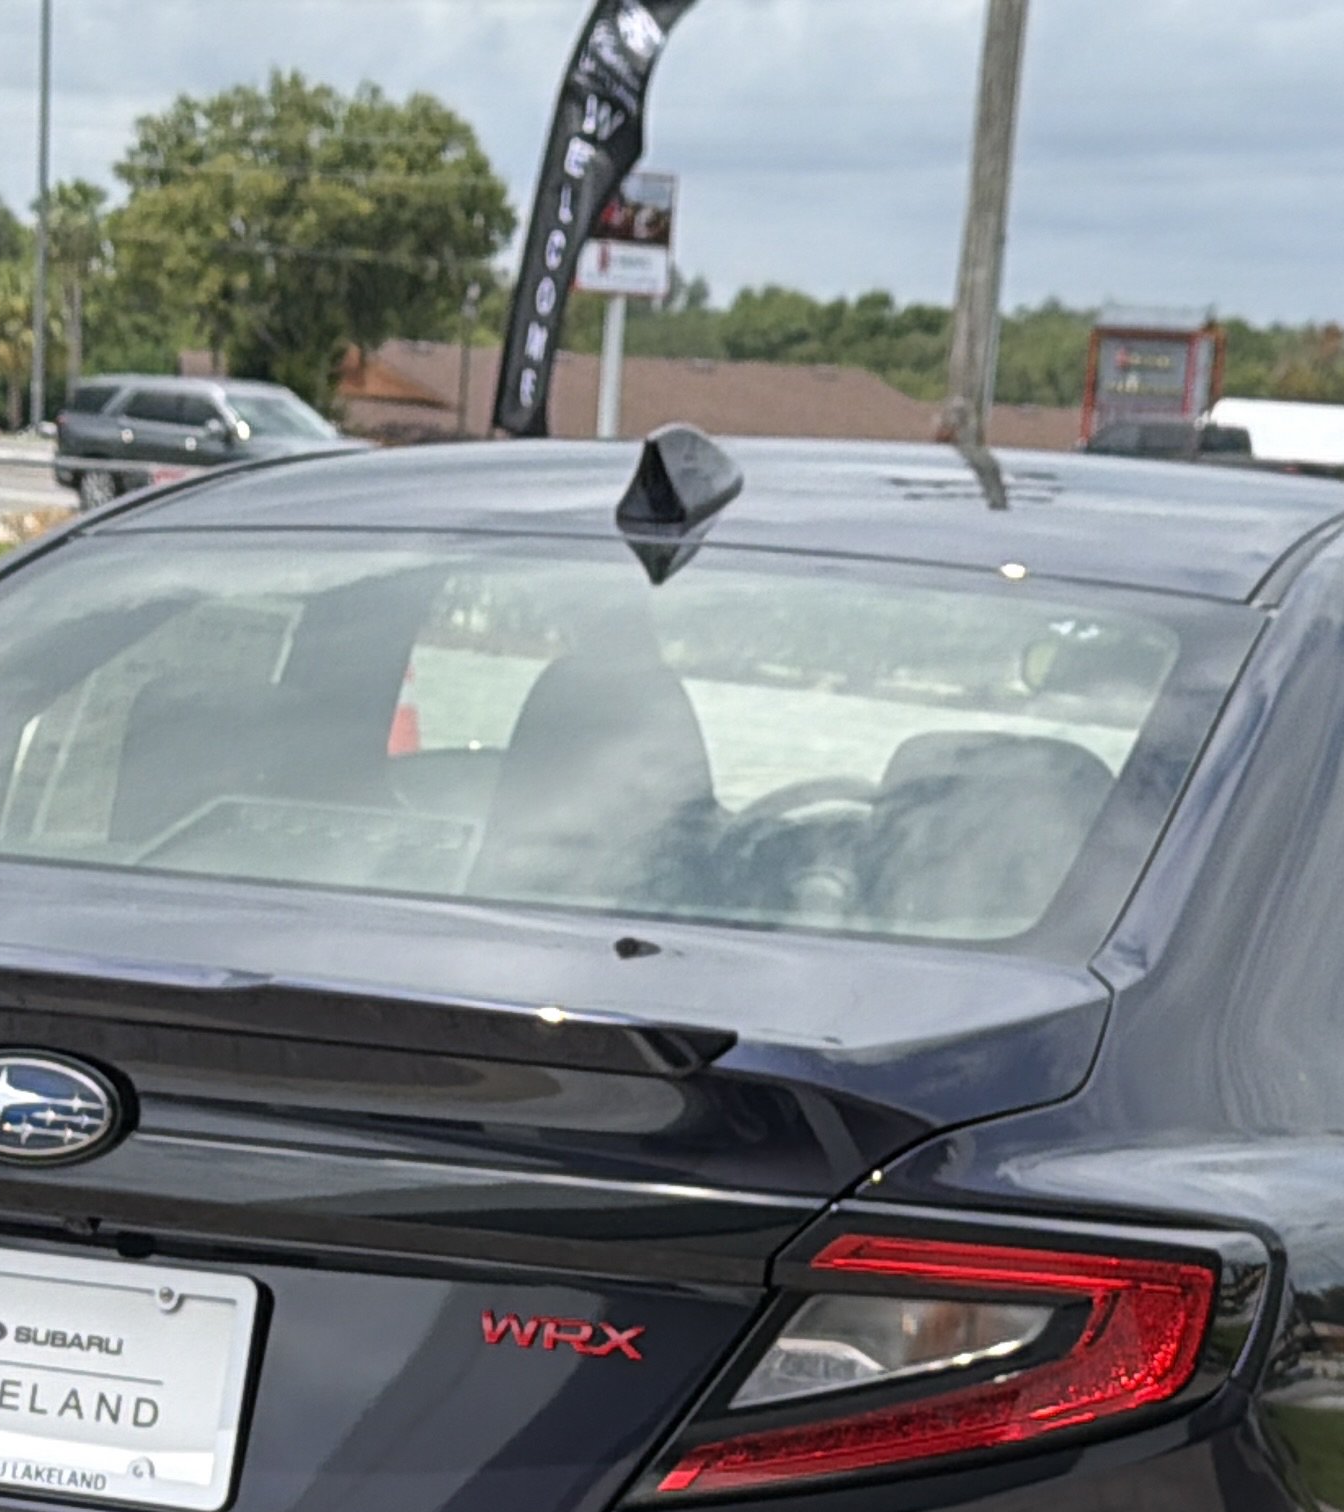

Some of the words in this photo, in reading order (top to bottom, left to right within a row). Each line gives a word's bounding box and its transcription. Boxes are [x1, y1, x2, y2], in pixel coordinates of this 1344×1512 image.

[14, 1315, 124, 1355] SUBARU
[482, 1310, 646, 1361] WRX
[11, 1462, 107, 1491] LAKELAND
